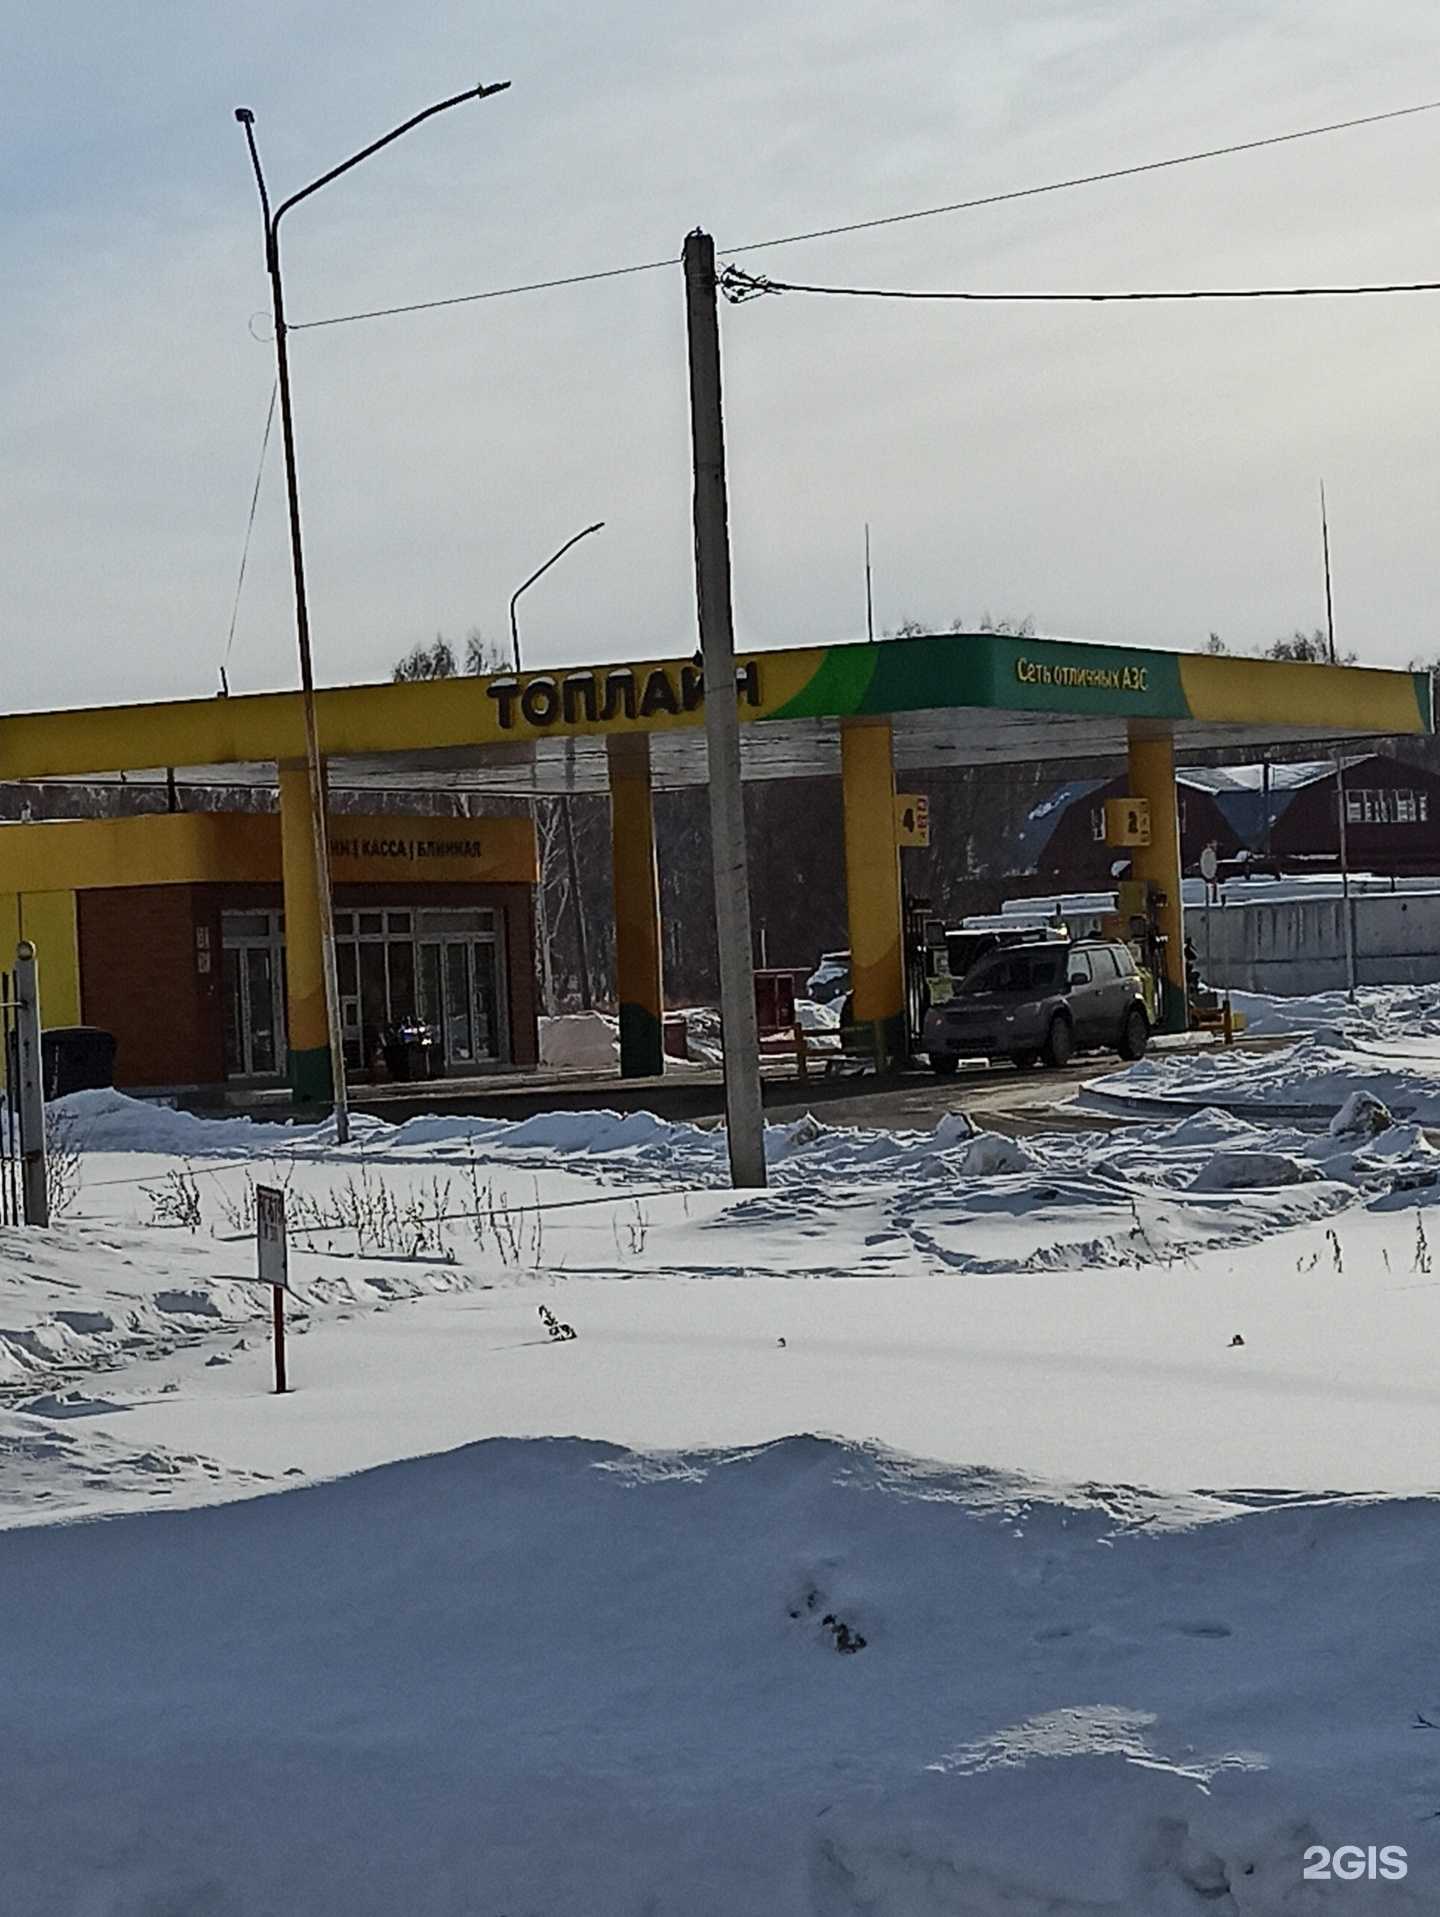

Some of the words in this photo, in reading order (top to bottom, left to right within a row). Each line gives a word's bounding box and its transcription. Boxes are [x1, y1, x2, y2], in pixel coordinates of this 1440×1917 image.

[1017, 656, 1051, 683] Сеть
[1122, 665, 1149, 691] АЗС
[903, 808, 914, 833] 4
[361, 839, 407, 857] КАССА
